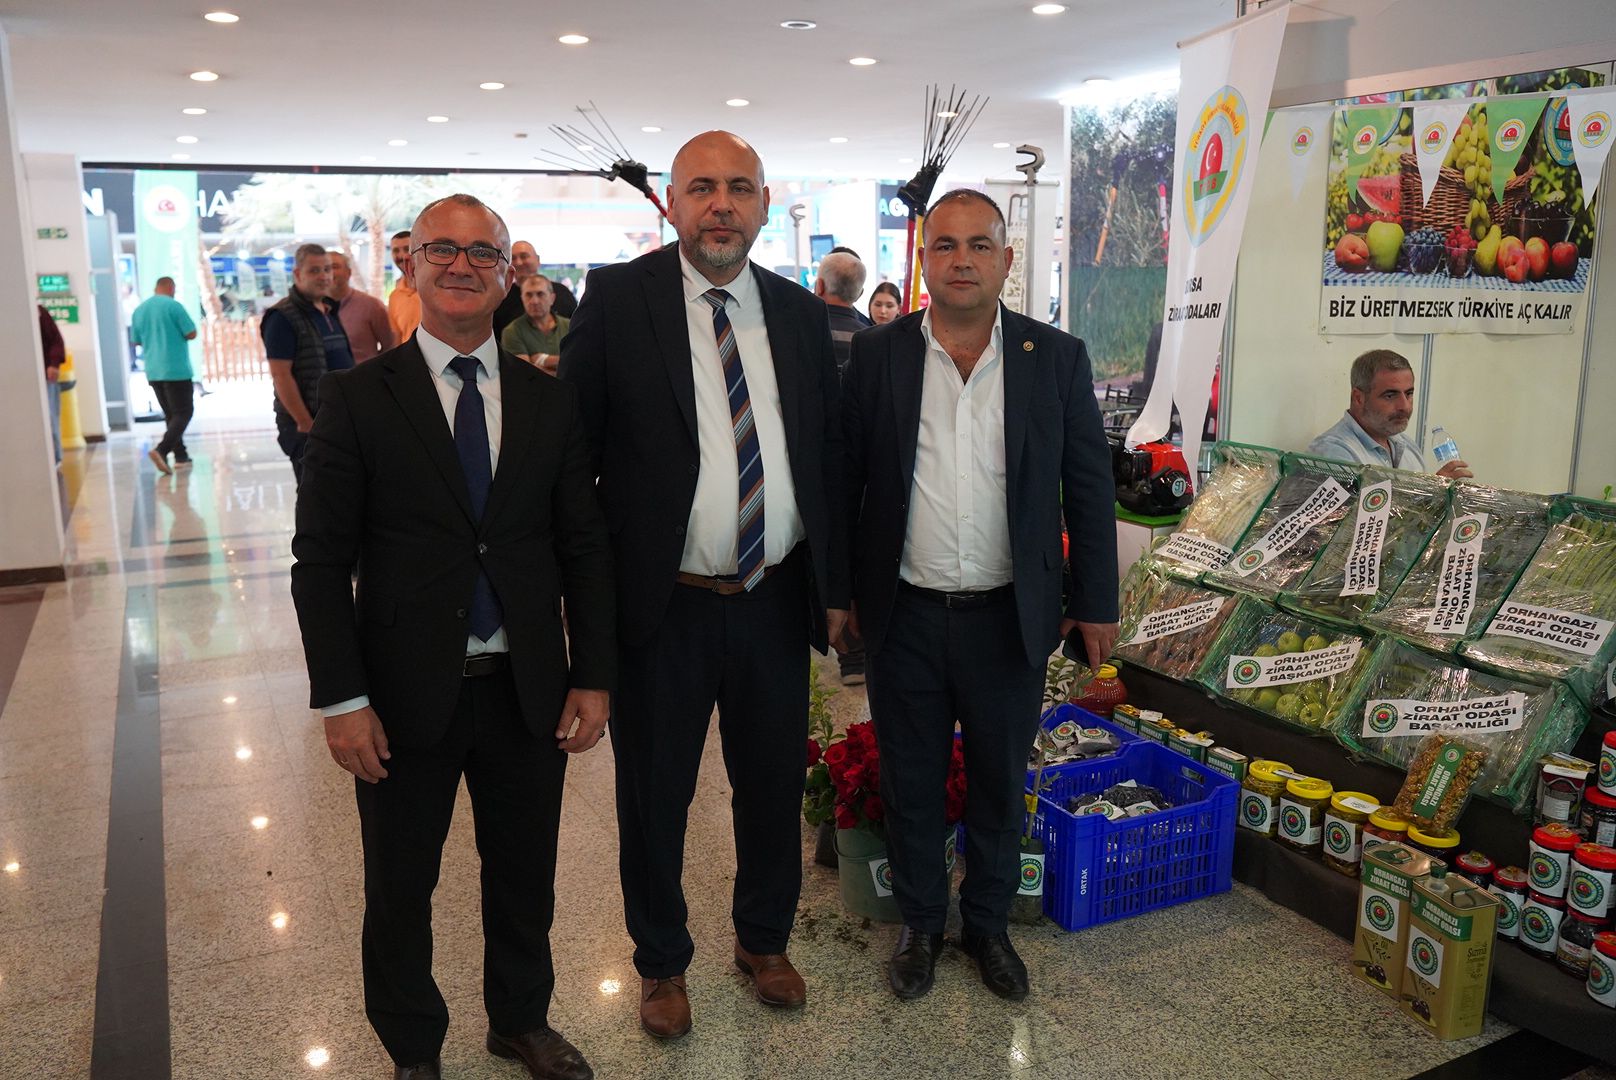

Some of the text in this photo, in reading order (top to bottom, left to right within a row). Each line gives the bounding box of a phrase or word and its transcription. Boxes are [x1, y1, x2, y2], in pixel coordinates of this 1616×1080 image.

[1329, 295, 1572, 324] BİZ ÜRETMEZSEK TÜRKİYE AÇ KALIR
[1266, 517, 1302, 551] ZİRAAT
[1305, 486, 1338, 517] ODASI
[1267, 486, 1327, 541] ORHANGAZİ
[1274, 497, 1340, 552] BAŞKANLIĞI
[1362, 516, 1376, 552] ZİRAAT
[1167, 548, 1219, 570] BAŞKANLIĞ
[1168, 541, 1199, 554] ZİRAAT
[1348, 522, 1366, 590] BAŞKANLIĞI
[1367, 519, 1383, 588] ORHANGAZİ
[1452, 548, 1467, 592] ZİRAAT
[1143, 618, 1180, 632] ZİRAAT
[1146, 614, 1211, 638] BAŞKANLIĞI
[1494, 614, 1600, 641] ZİRAAT ODASI
[1507, 607, 1598, 630] ORHANGAZİ
[1495, 623, 1588, 648] BAŞKANLIĞI
[1265, 663, 1311, 675] ZİRAAT
[1314, 653, 1355, 667] ODASI
[1274, 646, 1350, 666] ORHANGAZİ
[1270, 662, 1347, 682] BAŞKANLIĞI
[1402, 708, 1517, 721] ZİRAAT ODASI
[1414, 698, 1509, 713] ORHANGAZİ
[1080, 868, 1088, 895] ORTAK
